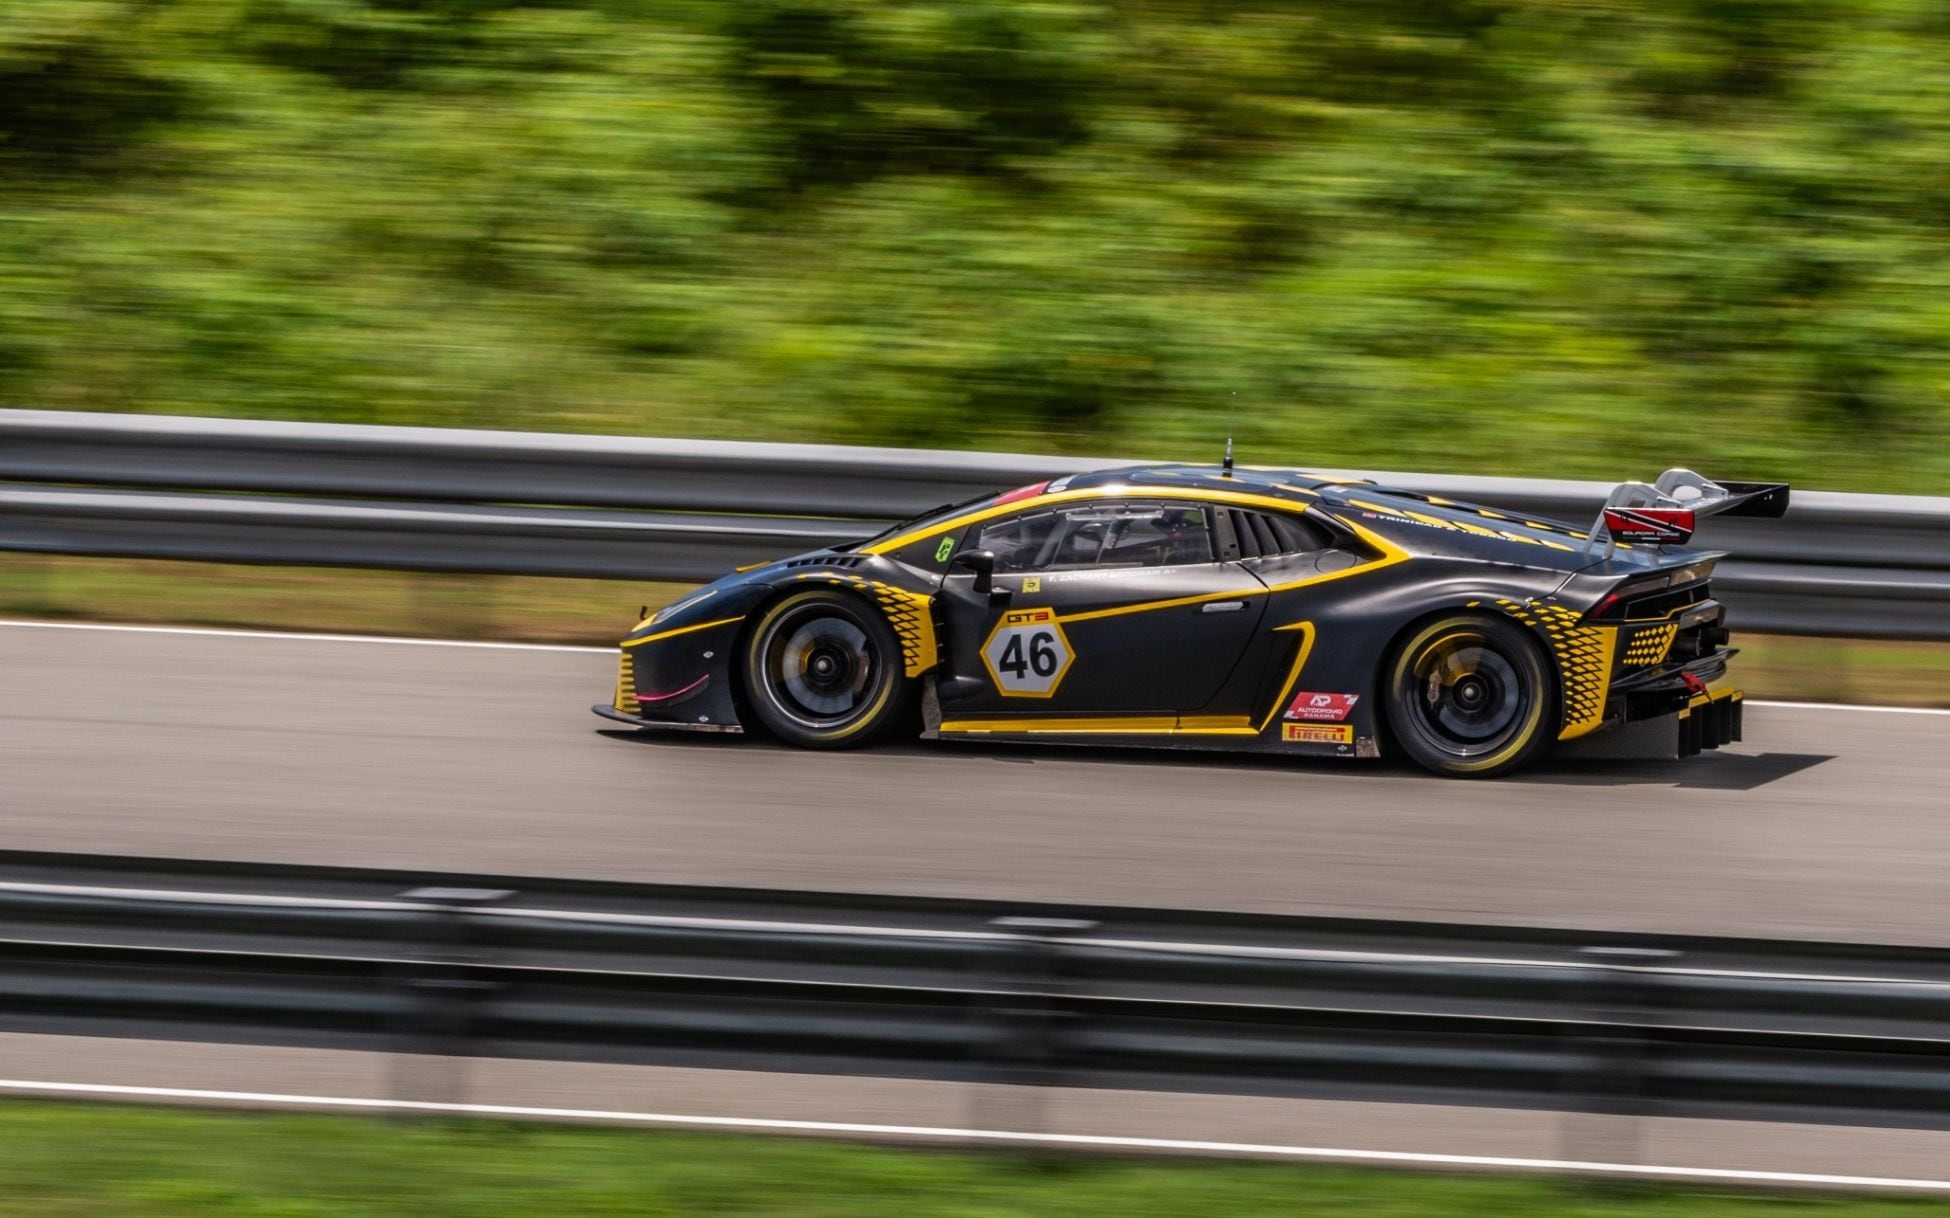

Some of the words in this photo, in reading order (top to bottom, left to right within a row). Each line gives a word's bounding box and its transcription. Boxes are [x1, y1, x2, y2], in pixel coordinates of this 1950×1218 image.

[1008, 612, 1049, 623] GT3
[999, 632, 1058, 680] 46
[1289, 725, 1345, 741] PIRELLI
